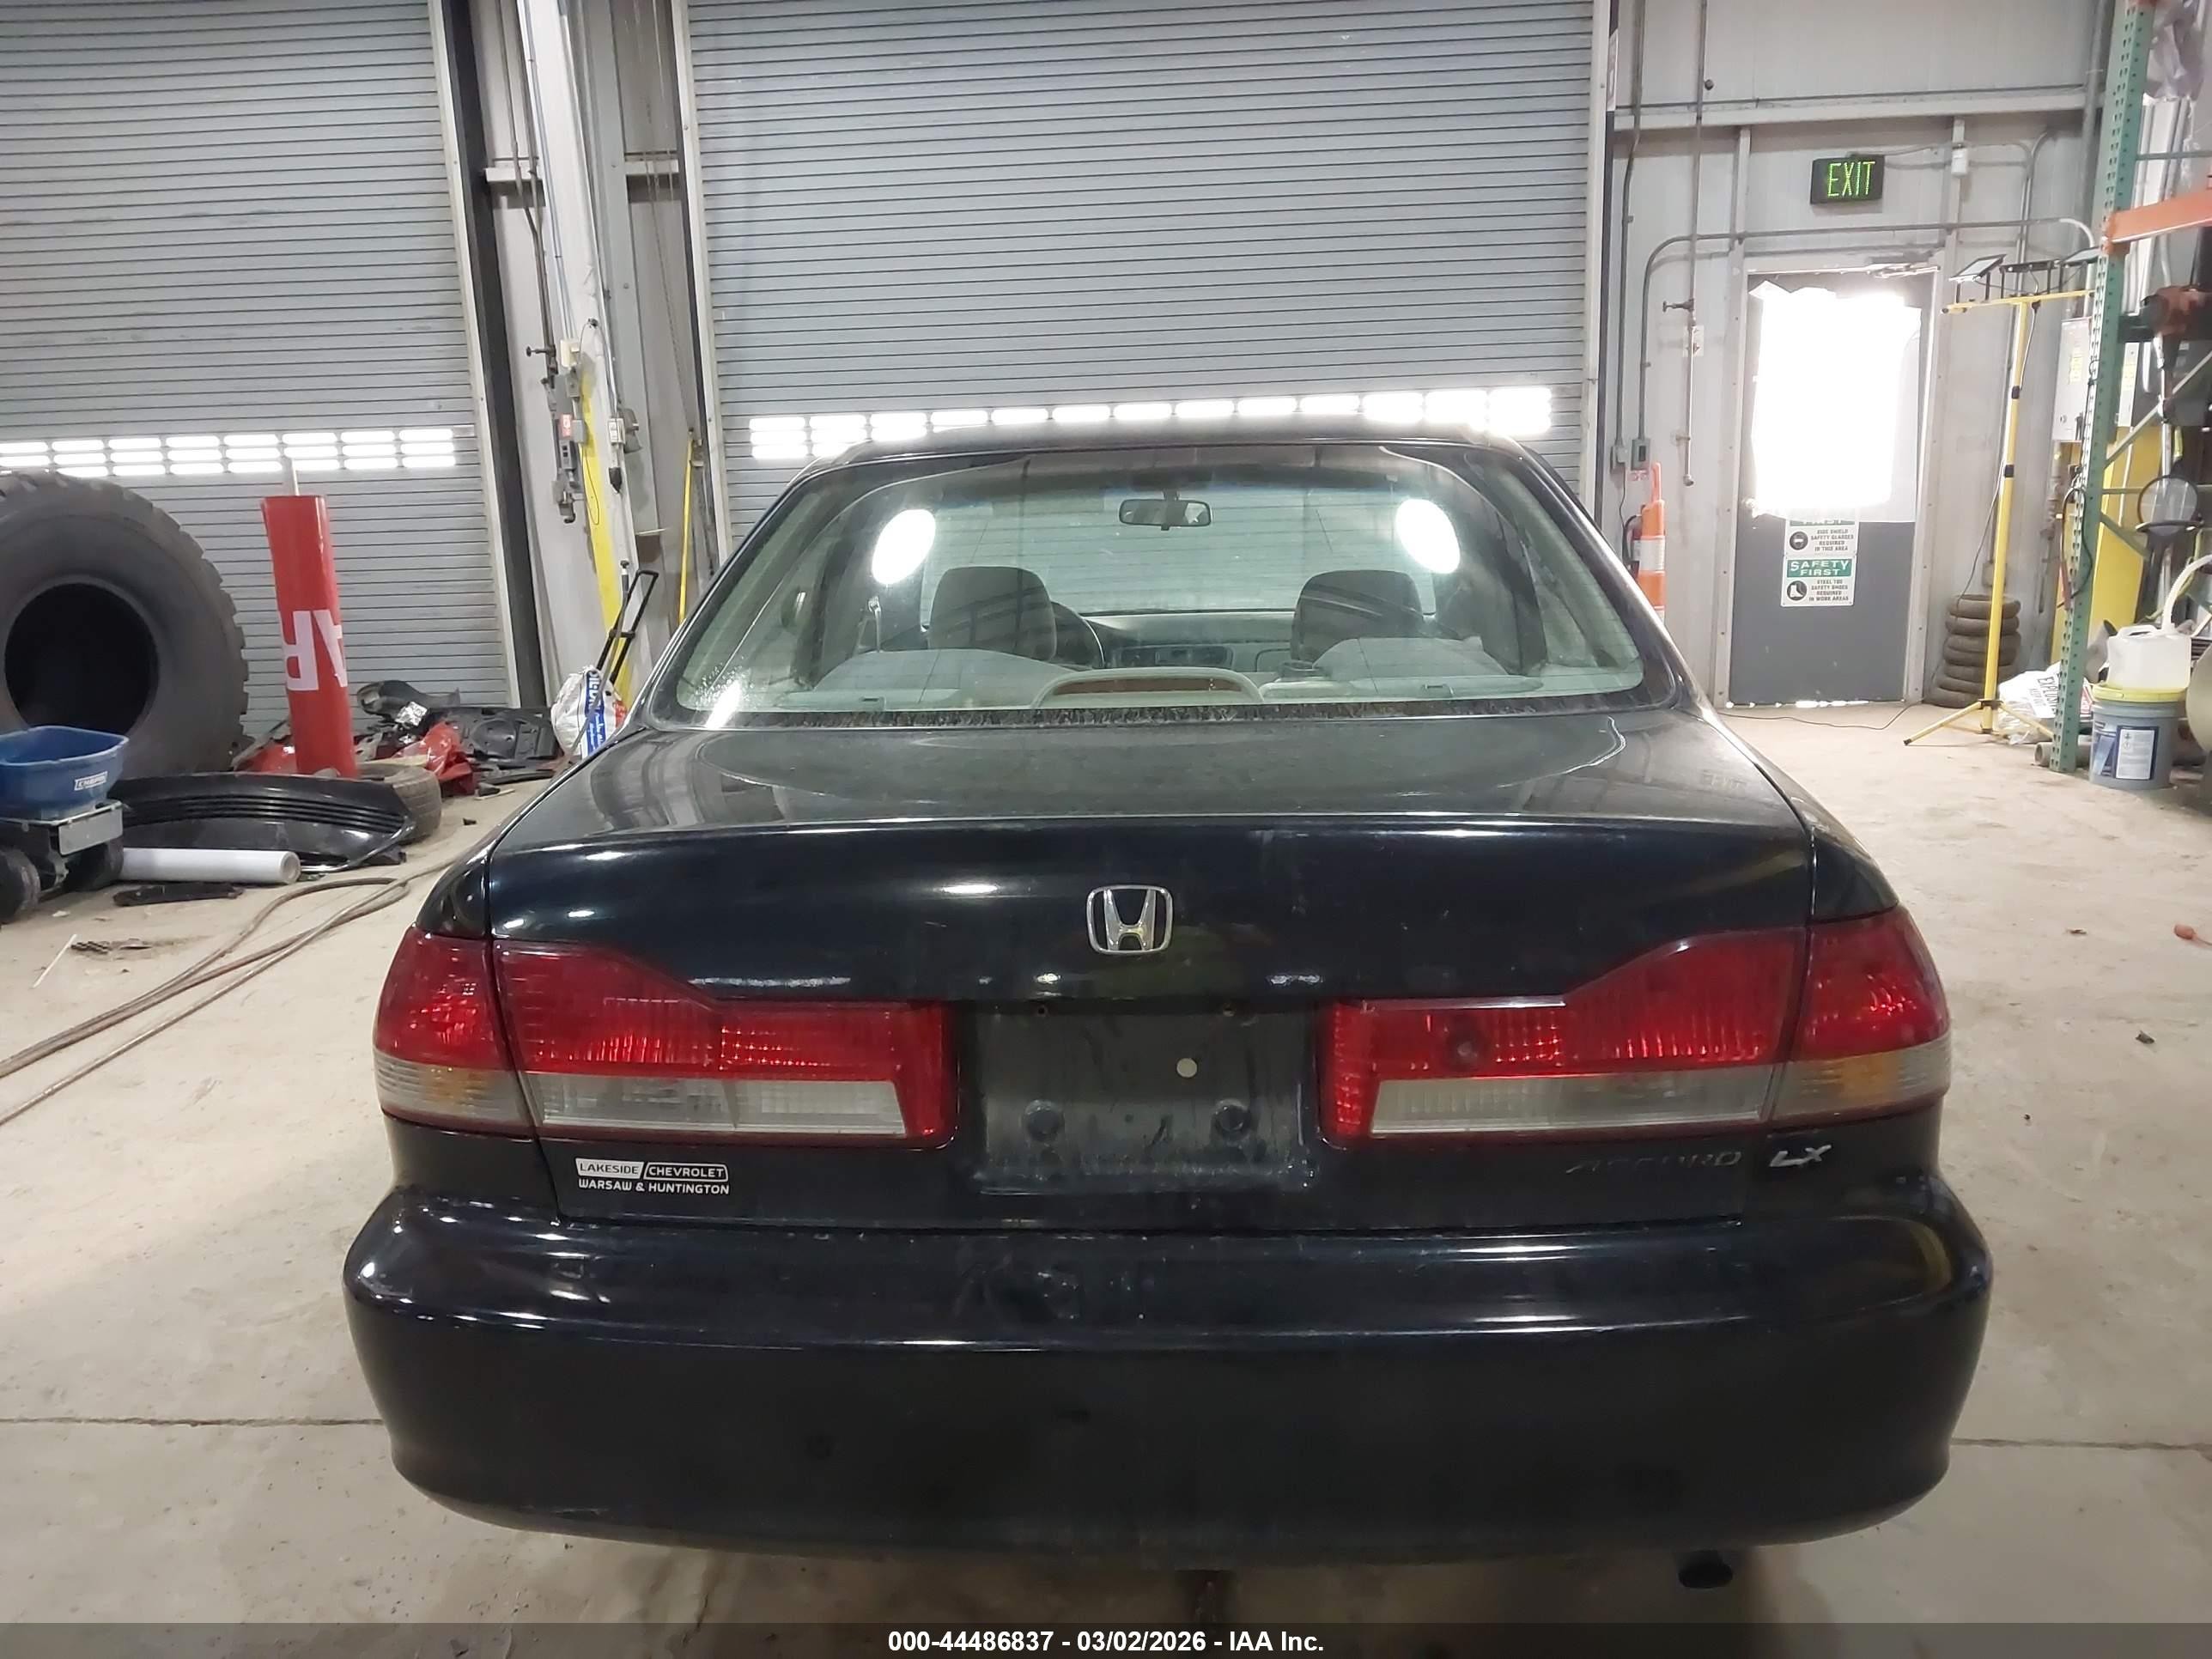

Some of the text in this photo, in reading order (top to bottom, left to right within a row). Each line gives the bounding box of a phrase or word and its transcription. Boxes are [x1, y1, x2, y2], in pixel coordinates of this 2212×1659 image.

[1827, 161, 1875, 197] EXIT
[1790, 560, 1849, 571] SAFETY
[1770, 1145, 1832, 1167] LX
[580, 1163, 724, 1177] LAKESIDE CHEVROLET
[578, 1178, 729, 1194] WARSAW & HUNTINGTON
